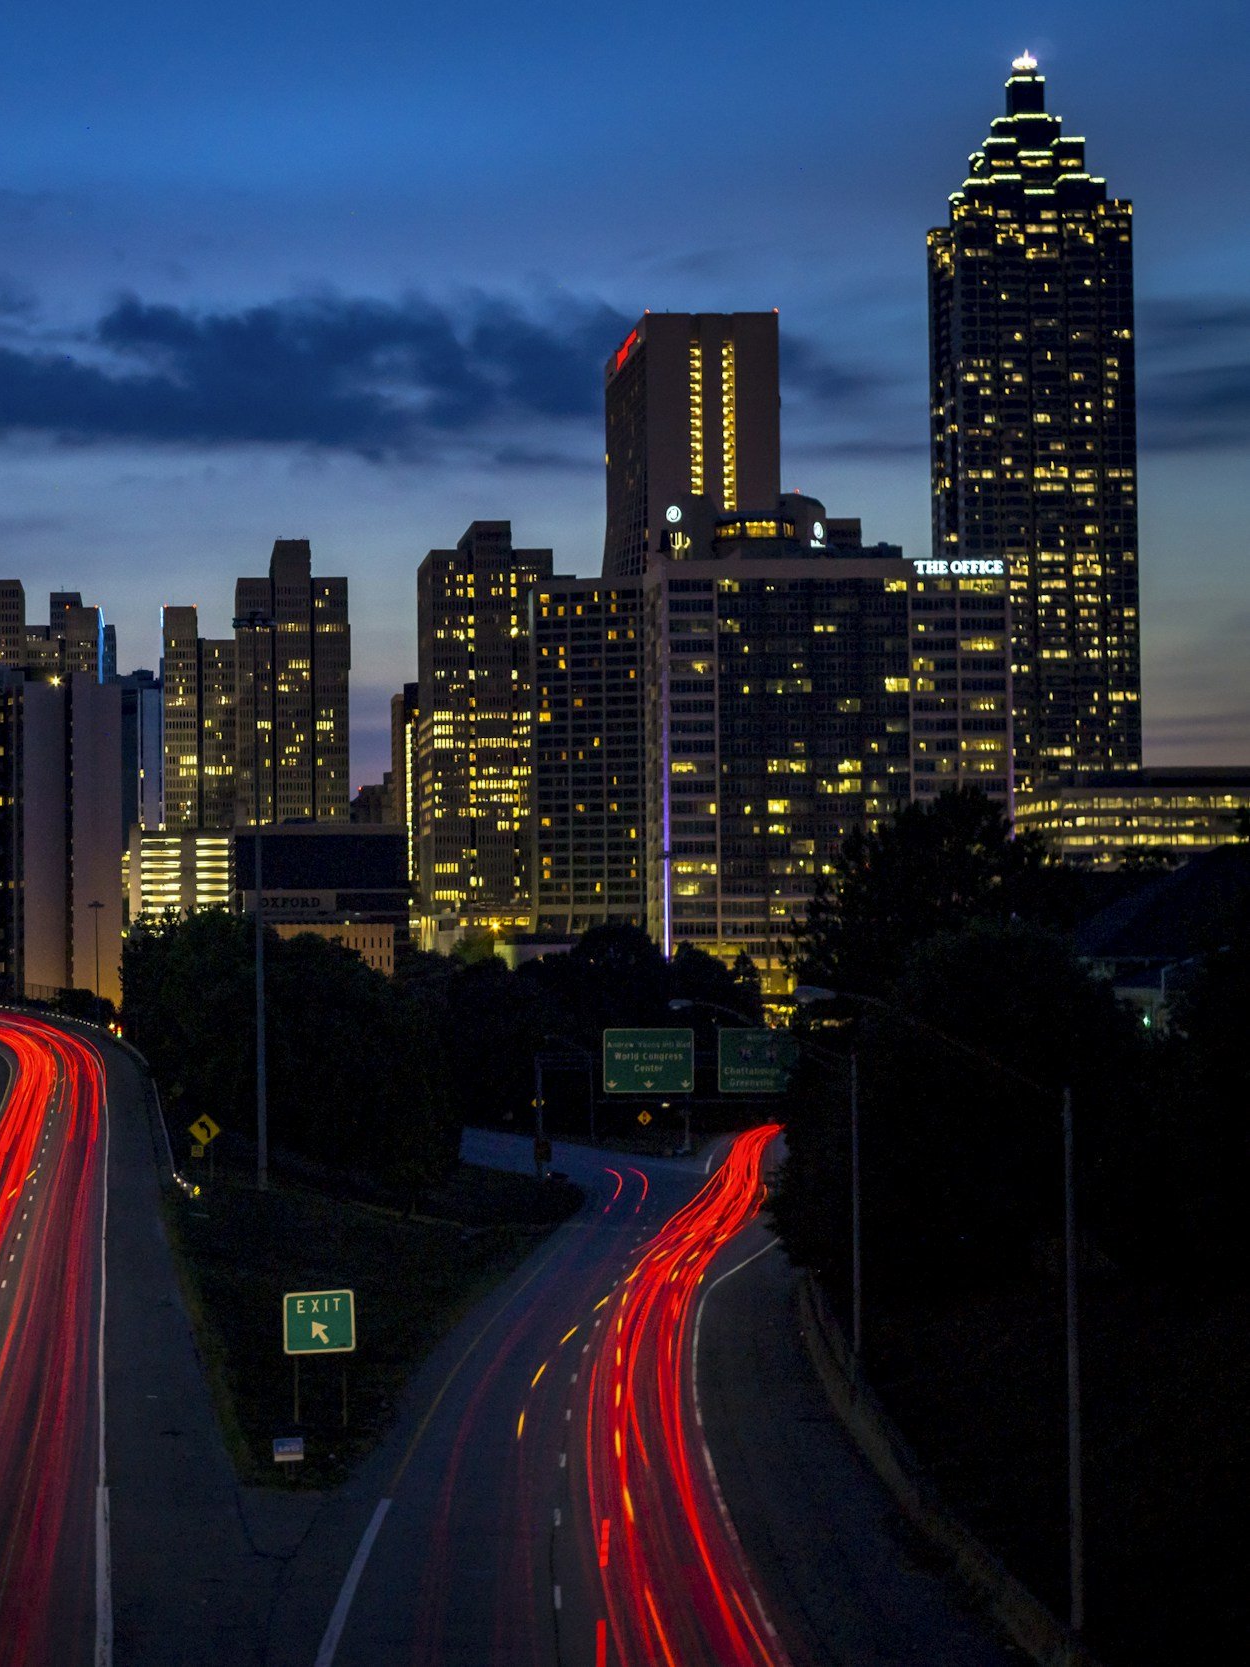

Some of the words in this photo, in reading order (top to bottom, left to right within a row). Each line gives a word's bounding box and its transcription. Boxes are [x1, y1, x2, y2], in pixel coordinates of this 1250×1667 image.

[913, 560, 949, 574] THE
[950, 560, 1004, 574] OFFICE
[260, 897, 320, 908] OXFORD
[614, 1052, 639, 1061] World
[642, 1052, 683, 1062] Congress
[634, 1064, 663, 1073] Center
[296, 1297, 341, 1314] EXIT
